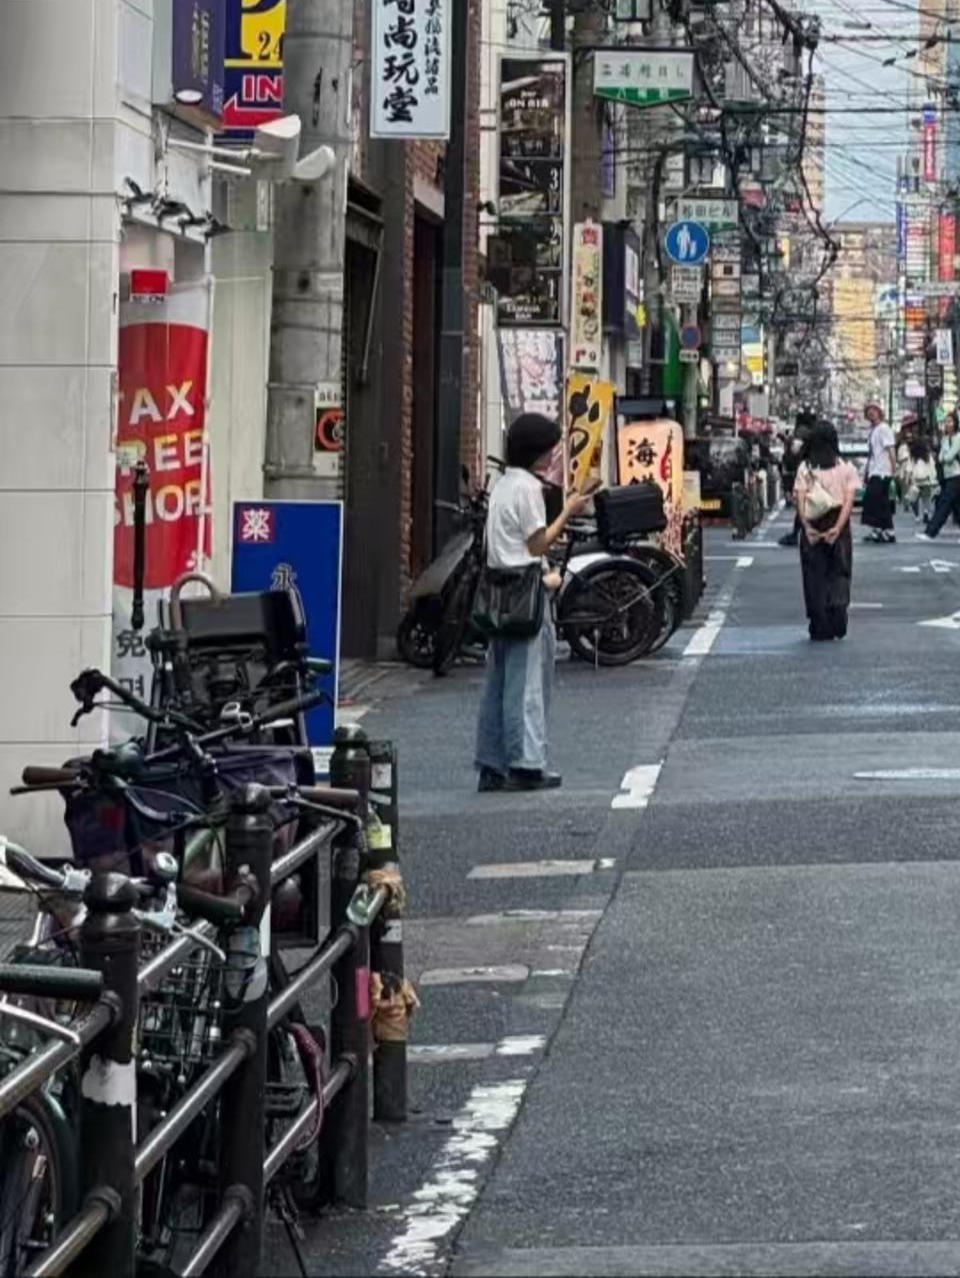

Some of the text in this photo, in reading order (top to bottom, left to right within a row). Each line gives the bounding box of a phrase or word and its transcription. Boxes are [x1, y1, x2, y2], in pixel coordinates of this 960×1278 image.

[241, 74, 284, 103] IN
[121, 379, 195, 425] AX
[118, 428, 203, 476] REE
[242, 507, 270, 542] 薬
